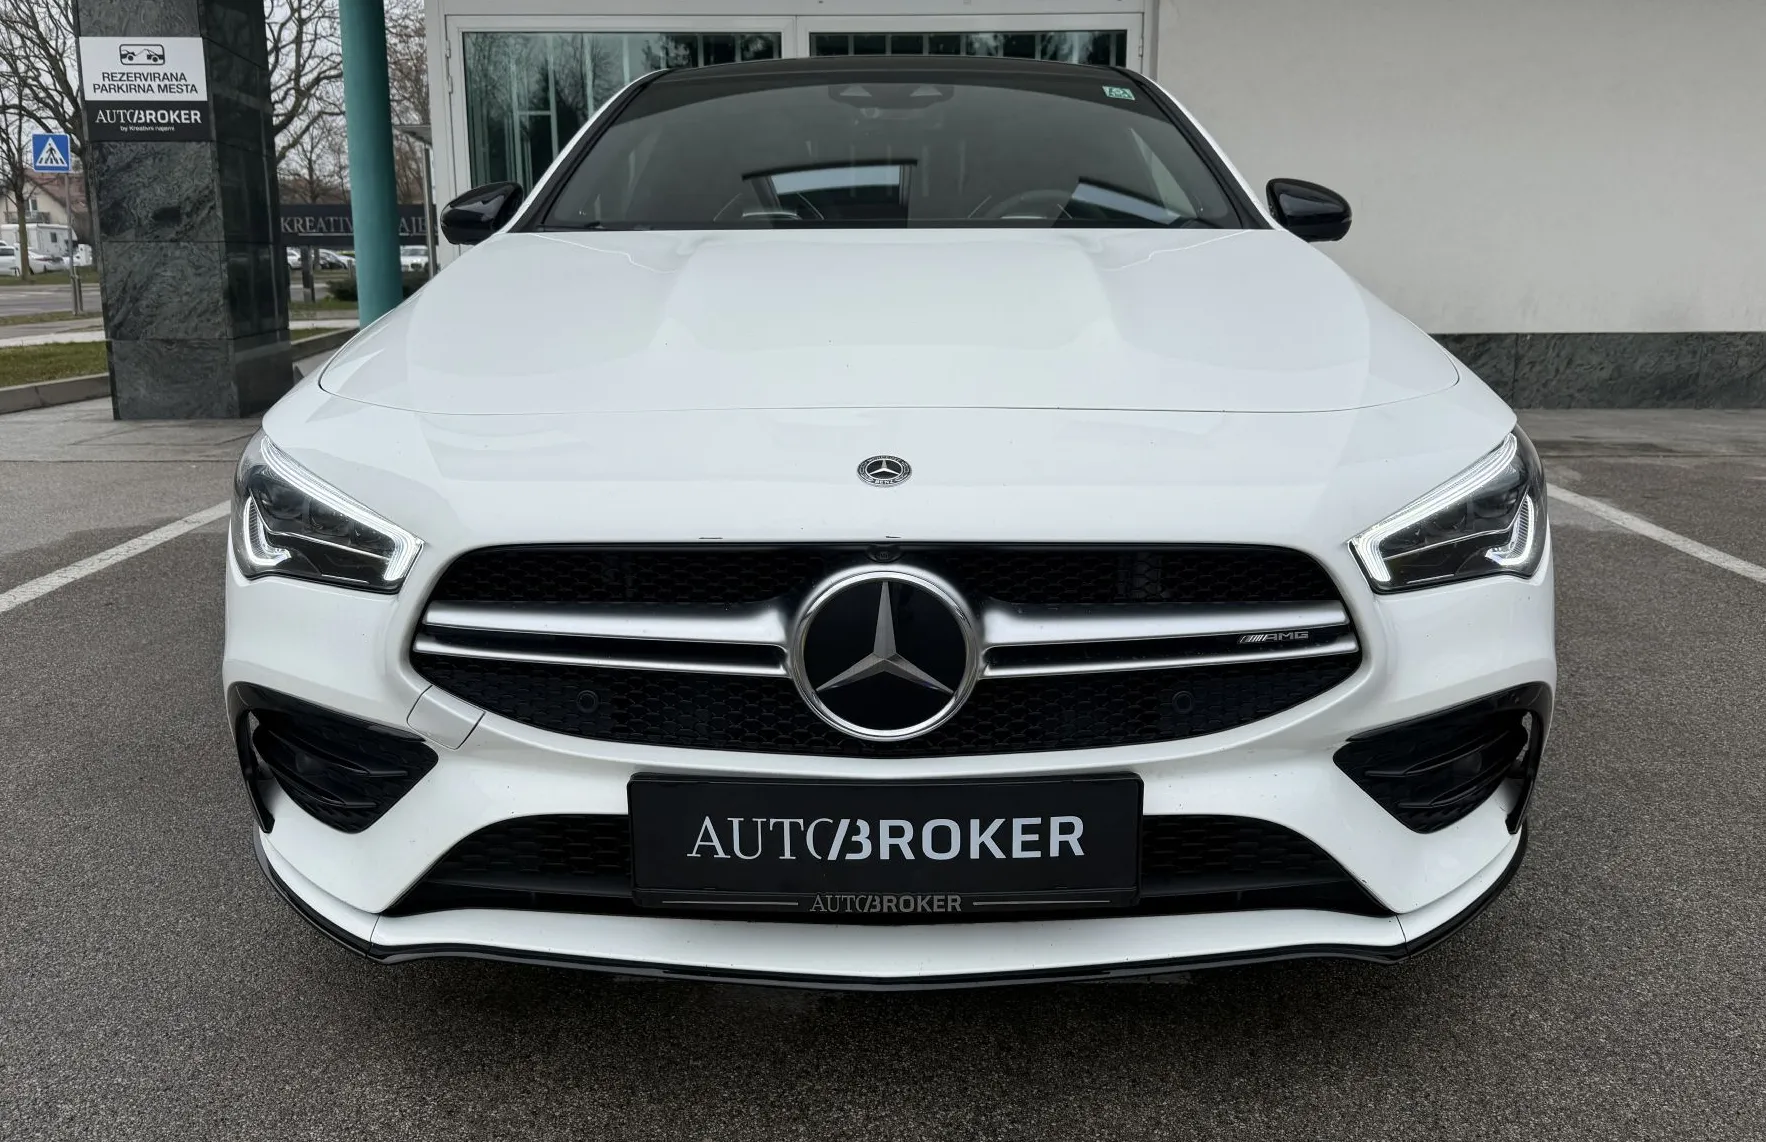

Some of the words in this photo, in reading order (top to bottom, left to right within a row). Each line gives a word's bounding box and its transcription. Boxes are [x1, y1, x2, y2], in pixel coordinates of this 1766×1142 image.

[102, 72, 188, 82] REZERVIRANA
[93, 83, 155, 94] PARKIRNA
[157, 83, 199, 94] MESTA
[280, 216, 354, 233] KREATIV
[1265, 631, 1309, 641] AMG
